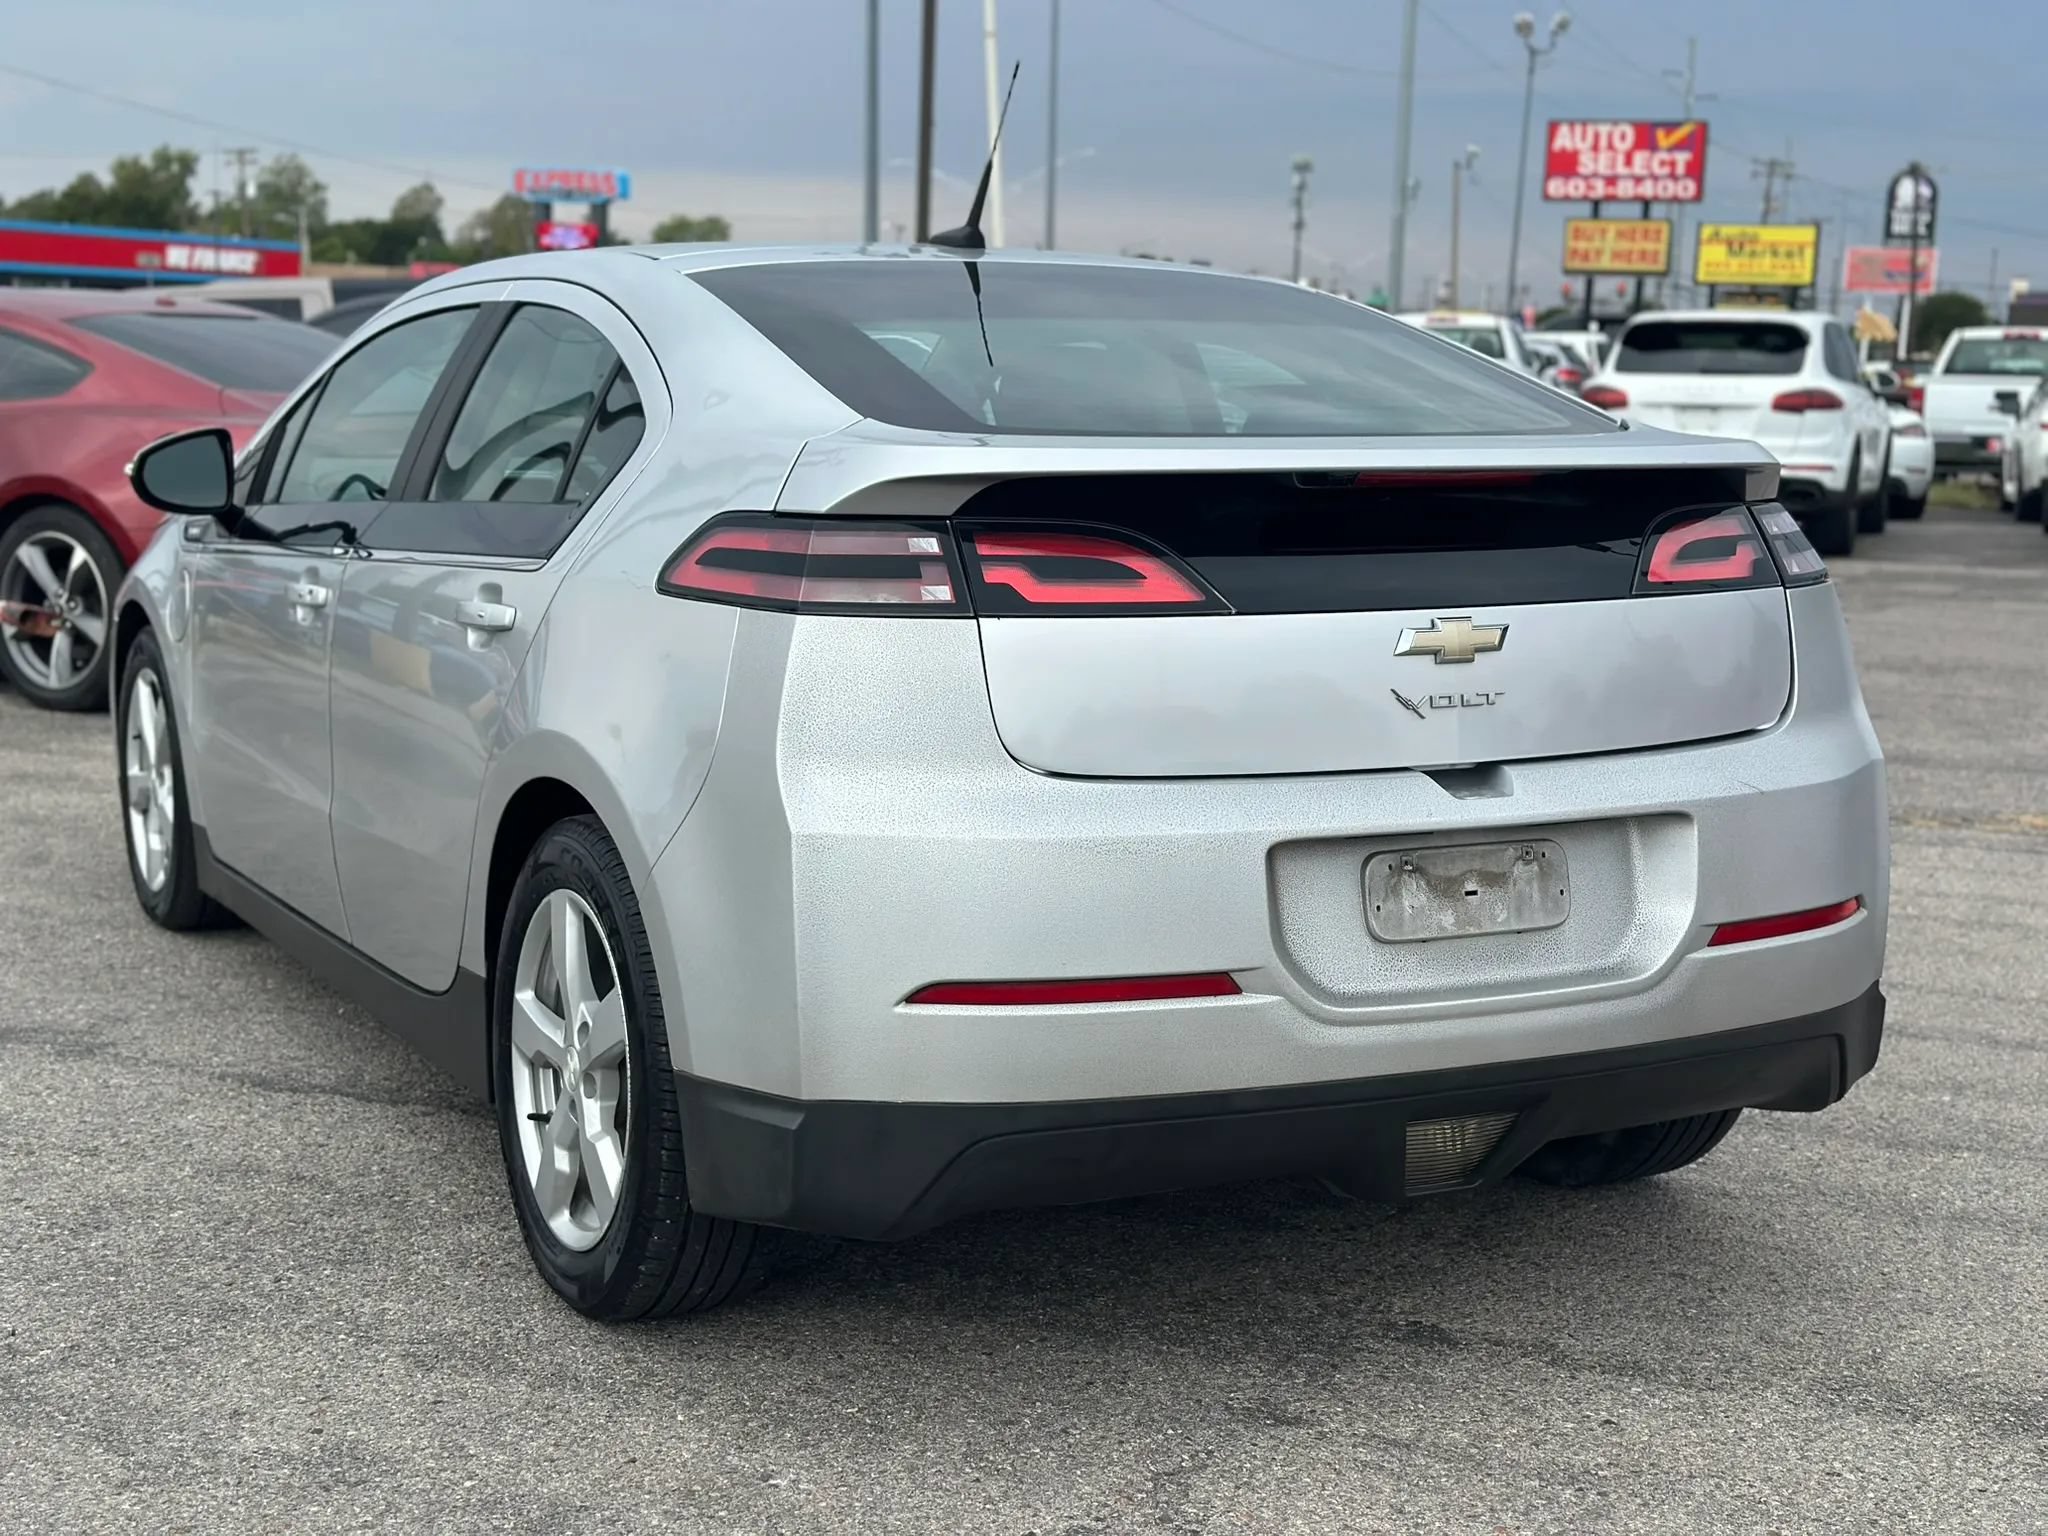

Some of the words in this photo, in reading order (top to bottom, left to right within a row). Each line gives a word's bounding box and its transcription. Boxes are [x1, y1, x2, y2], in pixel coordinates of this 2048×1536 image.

[1552, 123, 1636, 151] AUTO
[1577, 150, 1693, 175] SELECT
[1546, 176, 1698, 200] 603-8400
[1571, 226, 1608, 243] BUY
[1614, 226, 1663, 243] HERE
[1568, 247, 1605, 264] PAY
[1610, 248, 1660, 265] HERE
[1390, 687, 1507, 720] VOLT
